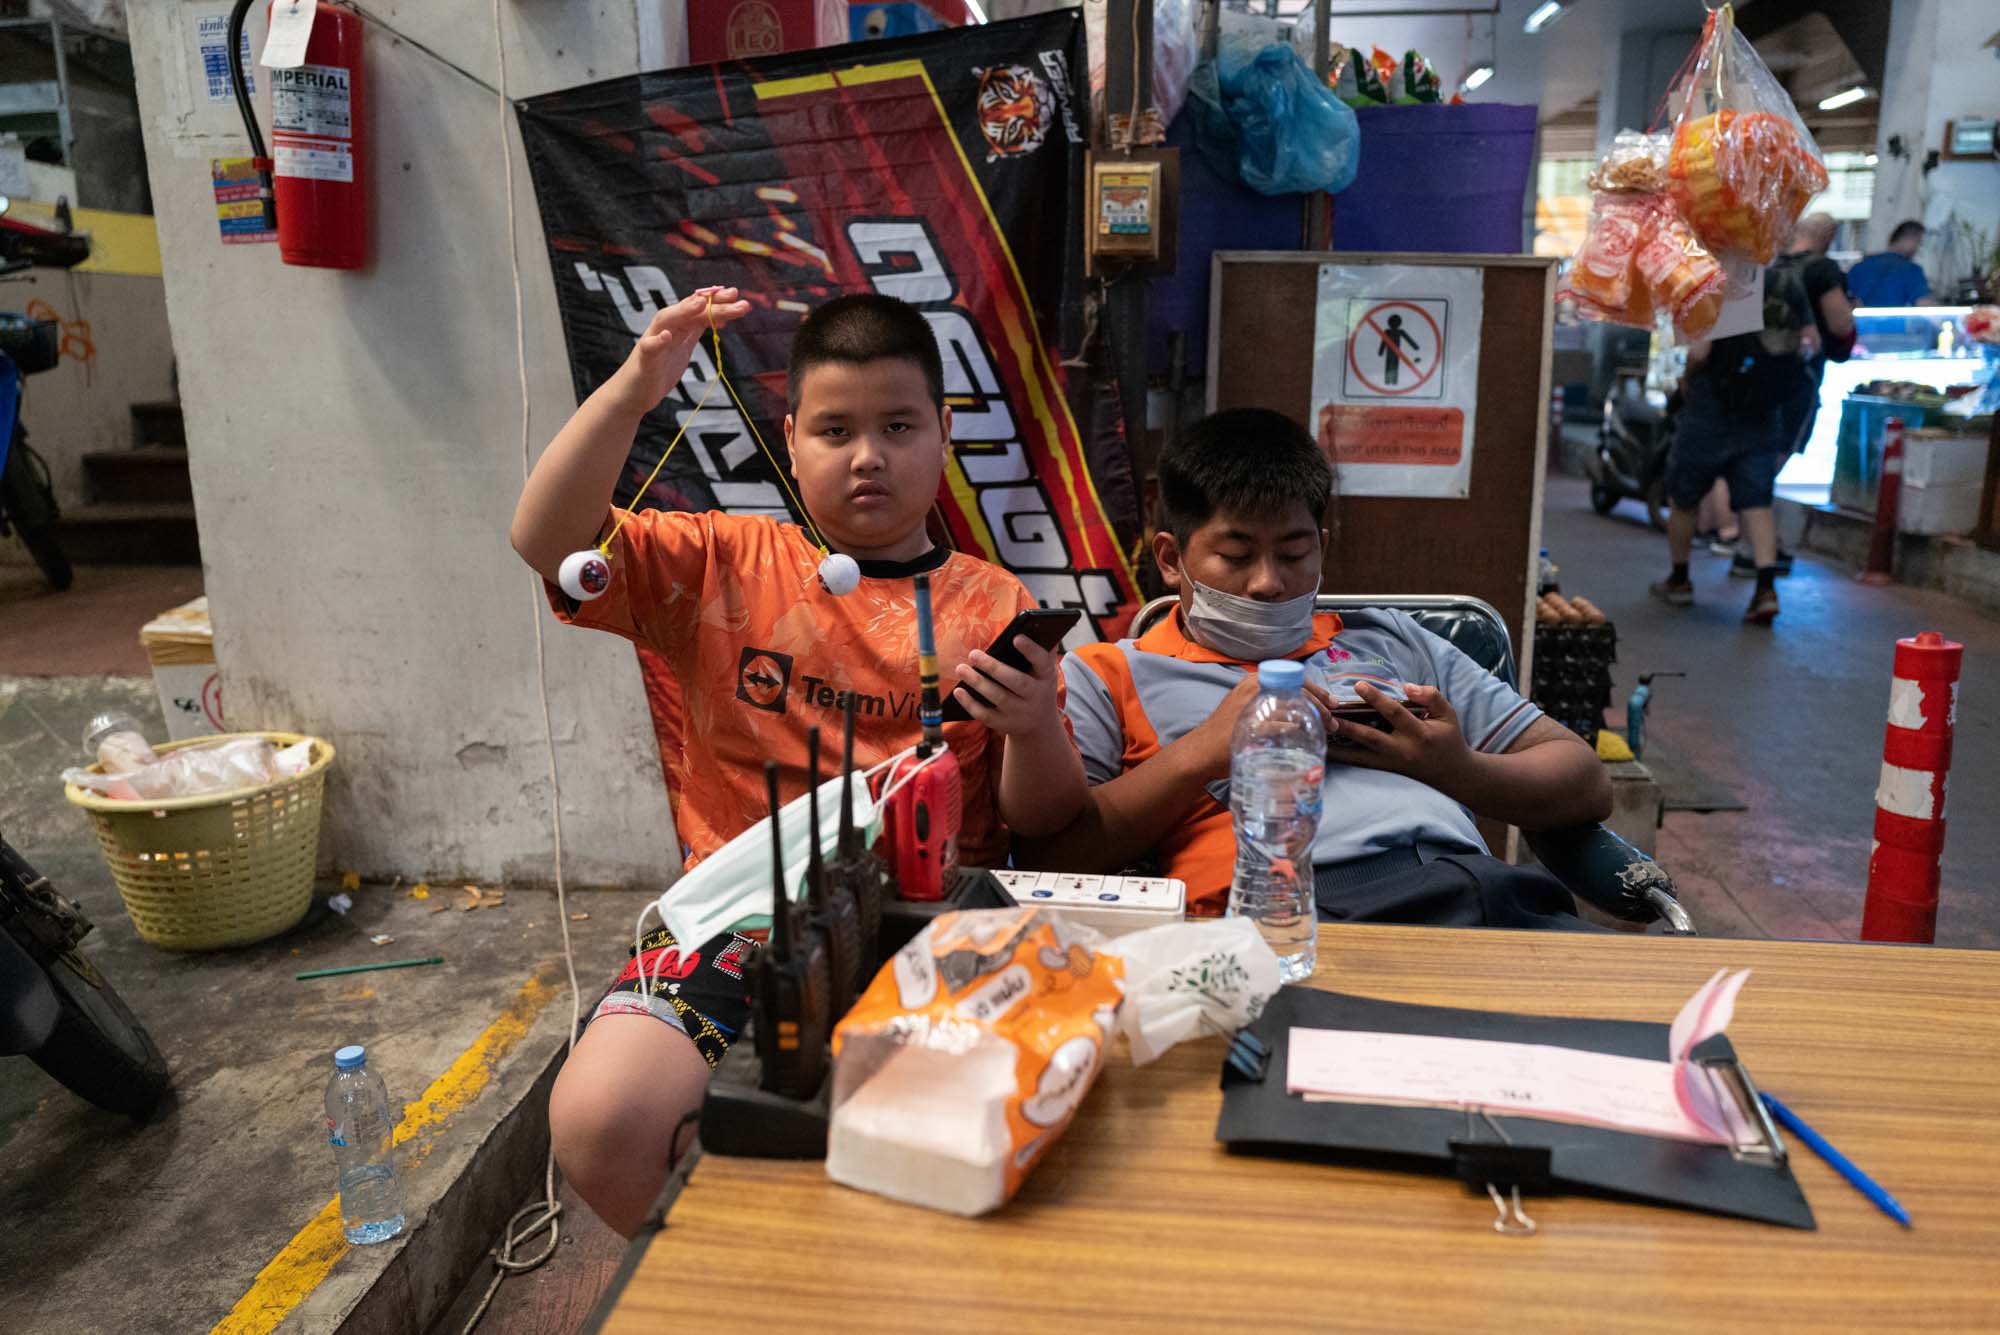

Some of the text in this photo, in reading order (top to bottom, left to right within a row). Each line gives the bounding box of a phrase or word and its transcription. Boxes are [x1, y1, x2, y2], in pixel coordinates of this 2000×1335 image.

[731, 31, 777, 50] LEO
[1039, 50, 1084, 142] RANGER
[802, 676, 922, 720] TeamVi
